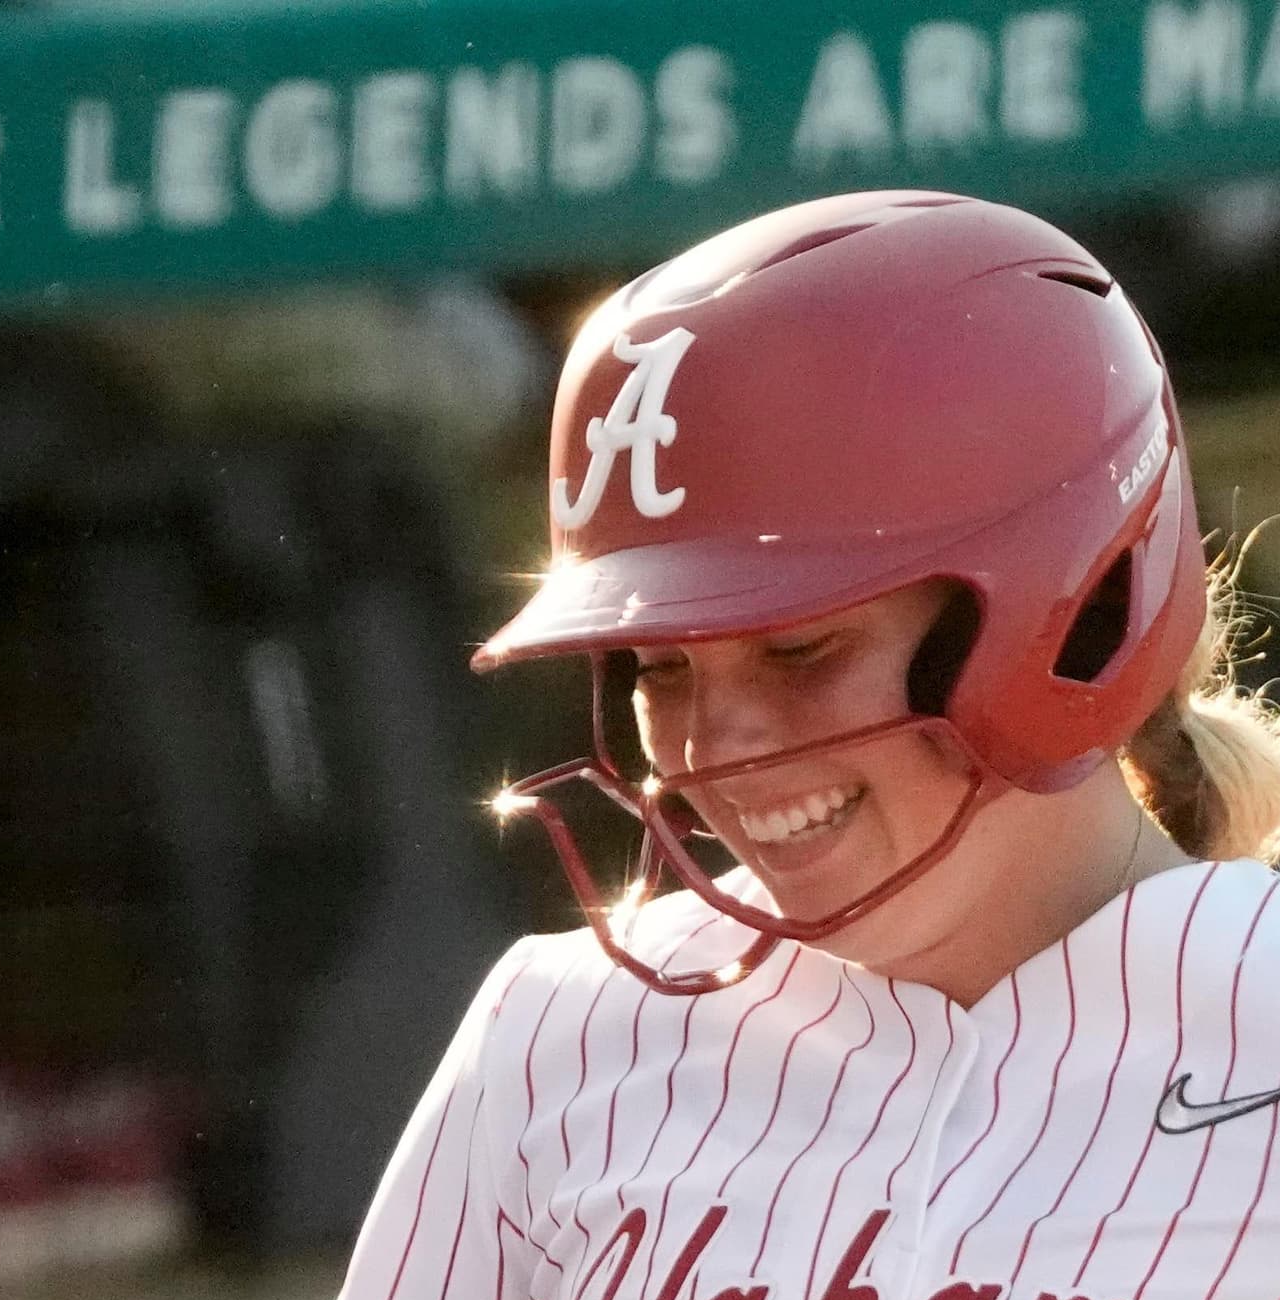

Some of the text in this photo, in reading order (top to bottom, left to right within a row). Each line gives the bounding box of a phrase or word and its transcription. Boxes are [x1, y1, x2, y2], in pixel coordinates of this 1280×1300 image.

[64, 43, 737, 236] LEGENDS
[792, 9, 1088, 172] ARE
[554, 326, 696, 530] A
[1118, 419, 1169, 504] EASTO
